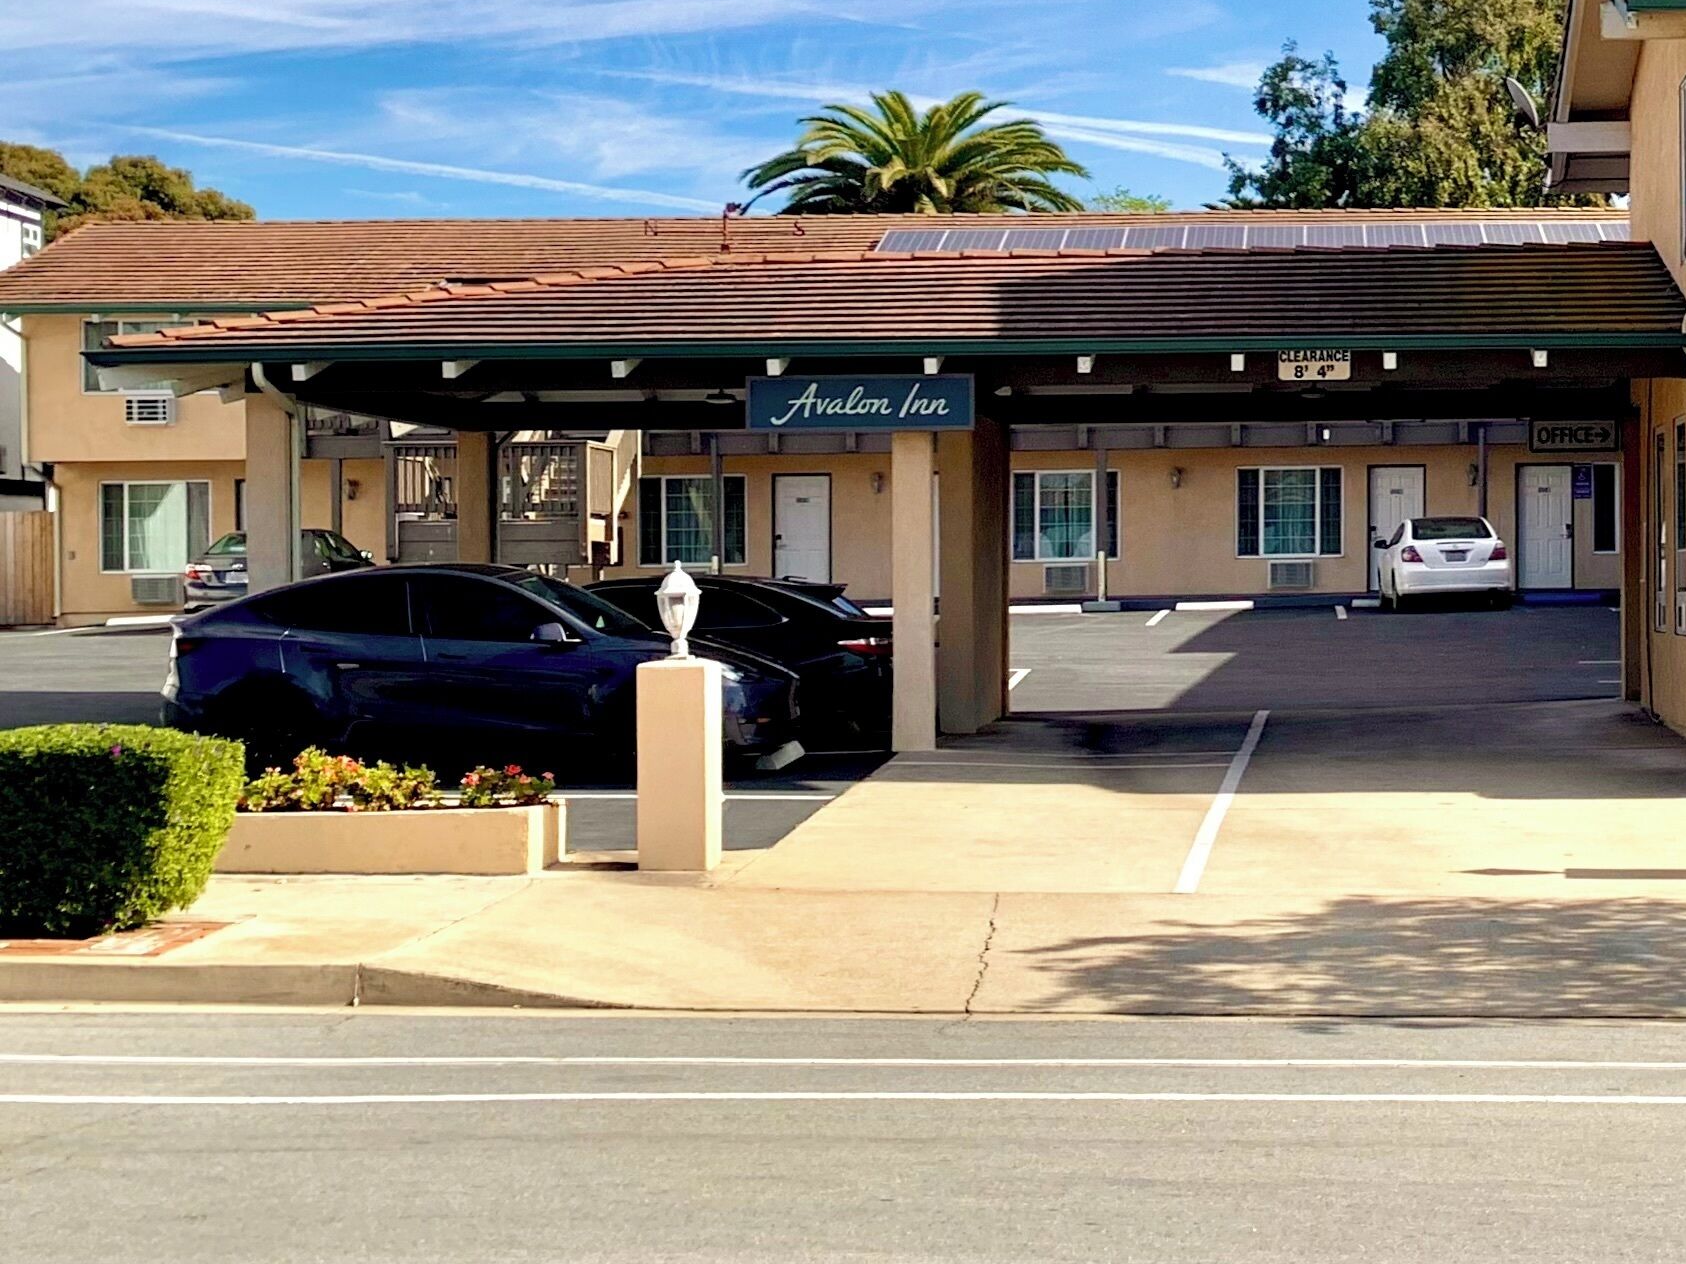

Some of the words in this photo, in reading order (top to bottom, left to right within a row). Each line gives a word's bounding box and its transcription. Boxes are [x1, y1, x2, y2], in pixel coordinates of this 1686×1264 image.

[1280, 350, 1349, 362] CLEARANCE
[1294, 365, 1308, 378] 8'
[770, 382, 892, 426] Avalon
[898, 382, 950, 418] Inn
[1536, 426, 1595, 445] OFFICE
